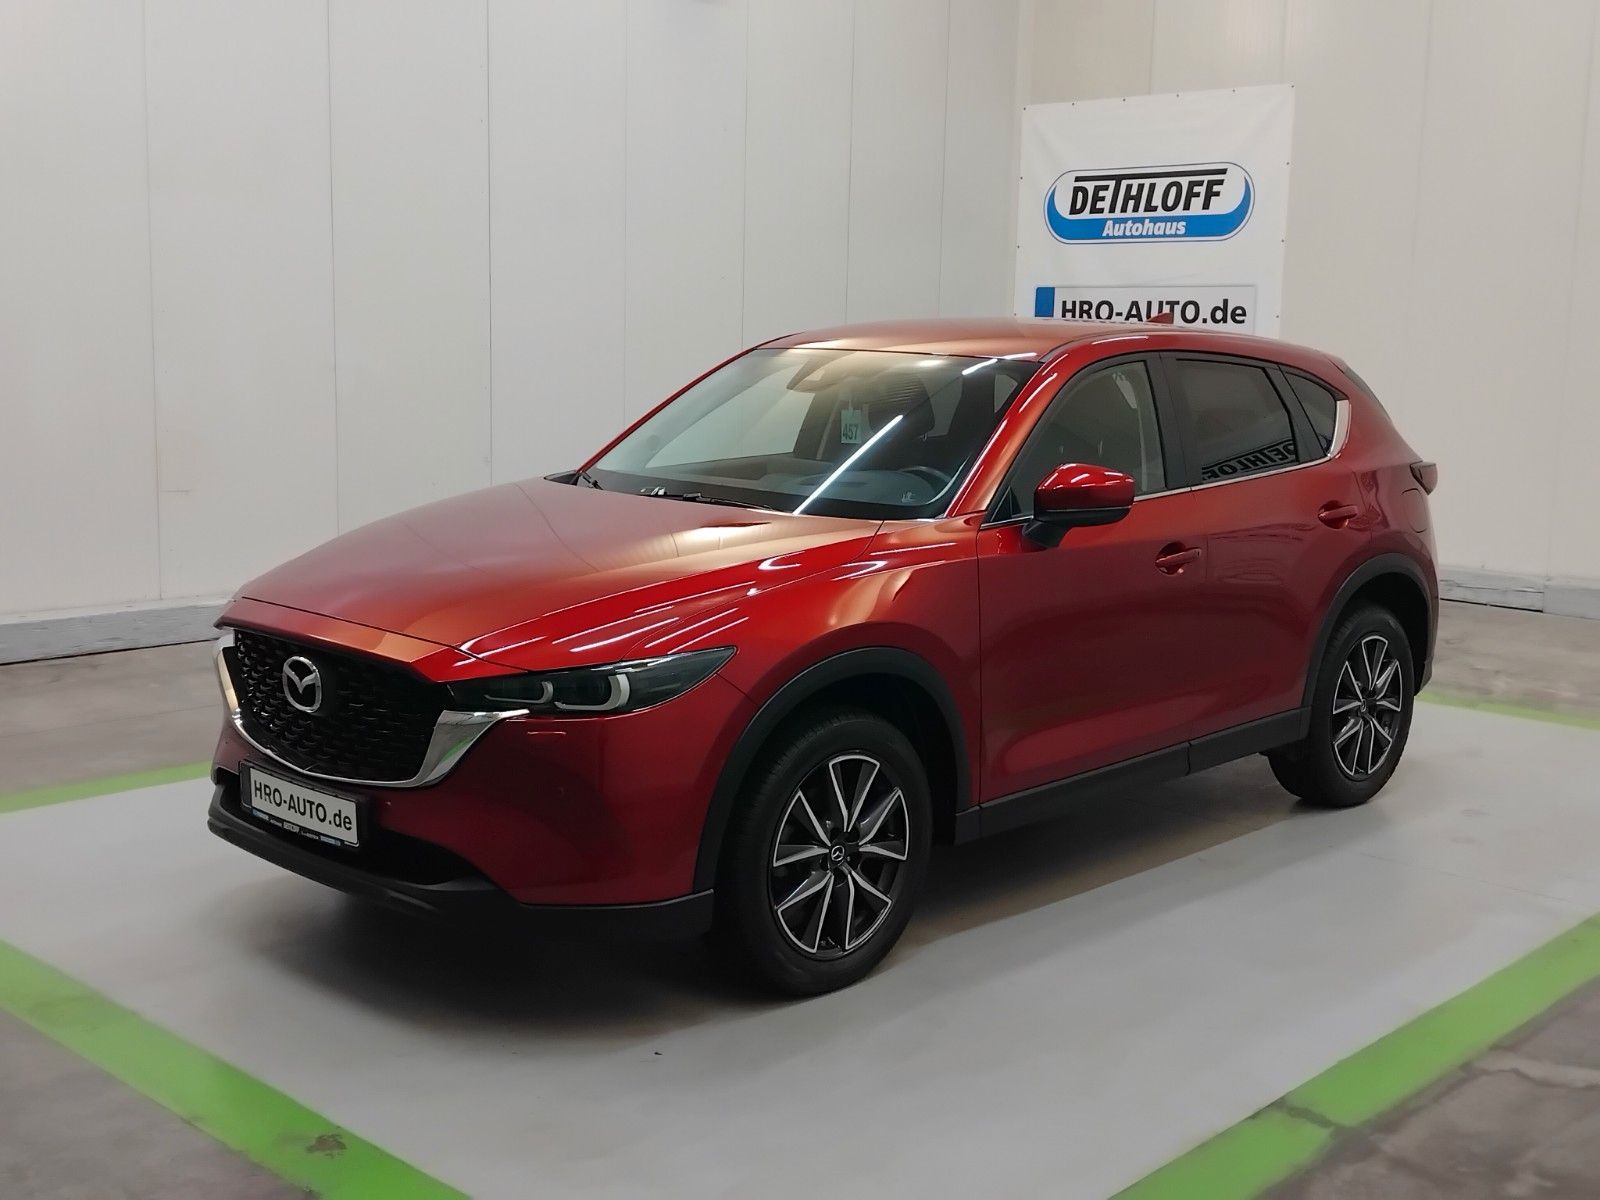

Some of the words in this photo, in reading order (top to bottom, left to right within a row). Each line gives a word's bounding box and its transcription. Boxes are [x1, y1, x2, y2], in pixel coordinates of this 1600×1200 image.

[1069, 168, 1228, 215] DETHLOFF
[1102, 219, 1186, 236] Autohaus
[1061, 299, 1247, 324] HRO-AUTO.de
[842, 423, 858, 440] 457
[254, 780, 352, 831] HRO-AUTO.de
